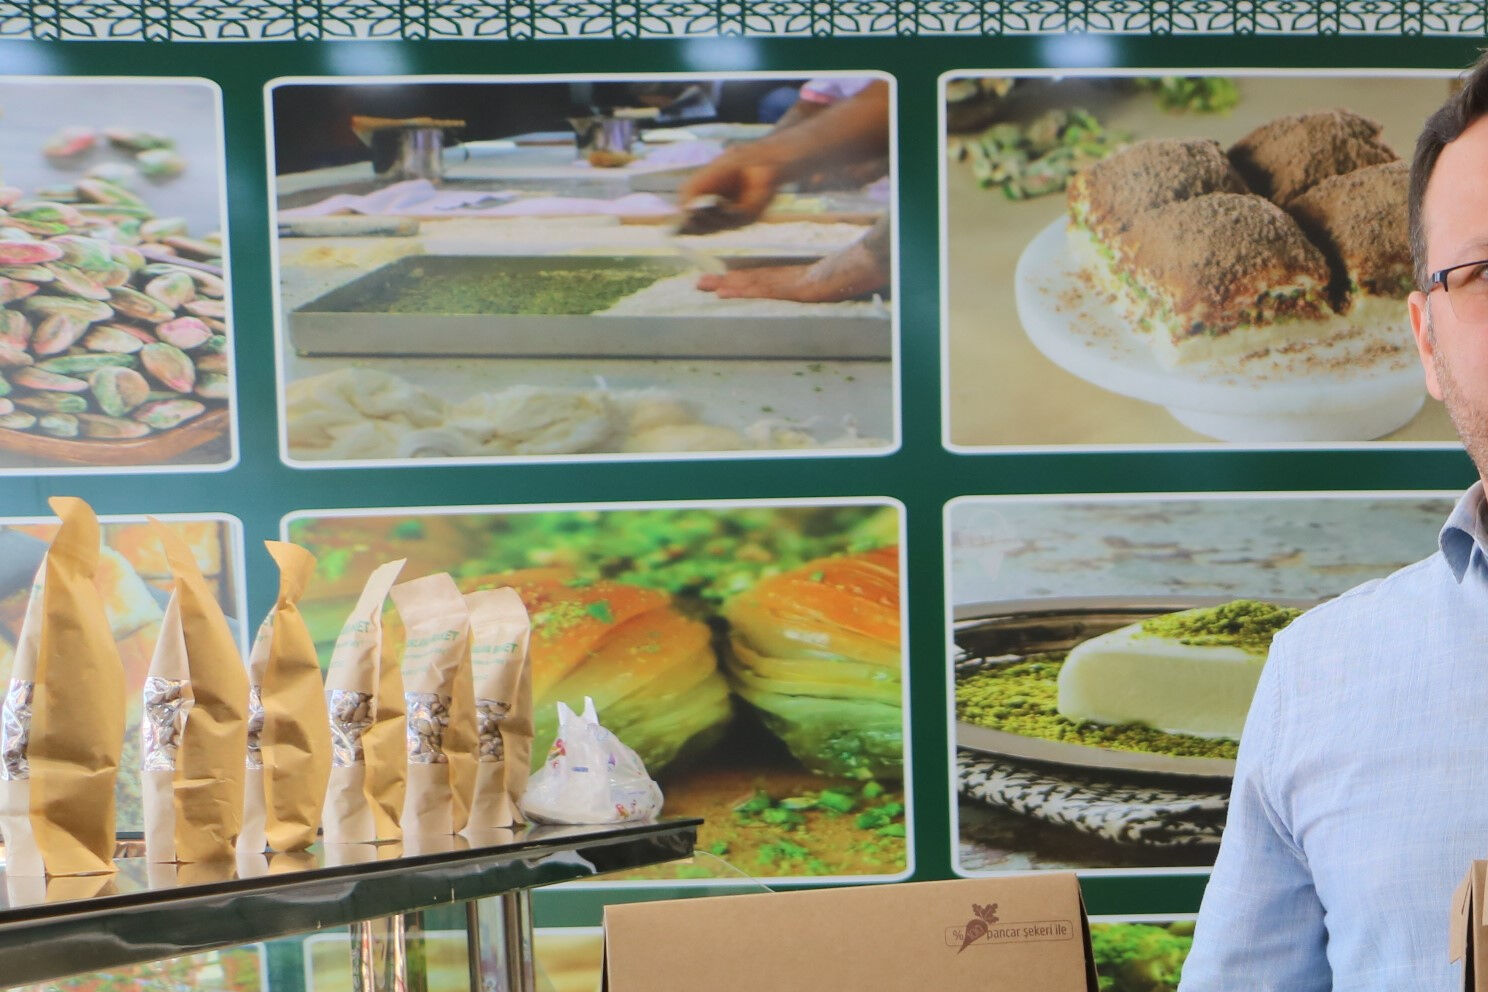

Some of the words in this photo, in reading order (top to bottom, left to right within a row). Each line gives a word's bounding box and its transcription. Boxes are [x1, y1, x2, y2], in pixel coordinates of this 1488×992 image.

[987, 929, 1021, 941] pancar
[1024, 924, 1052, 938] şekeri
[1055, 924, 1067, 935] ile
